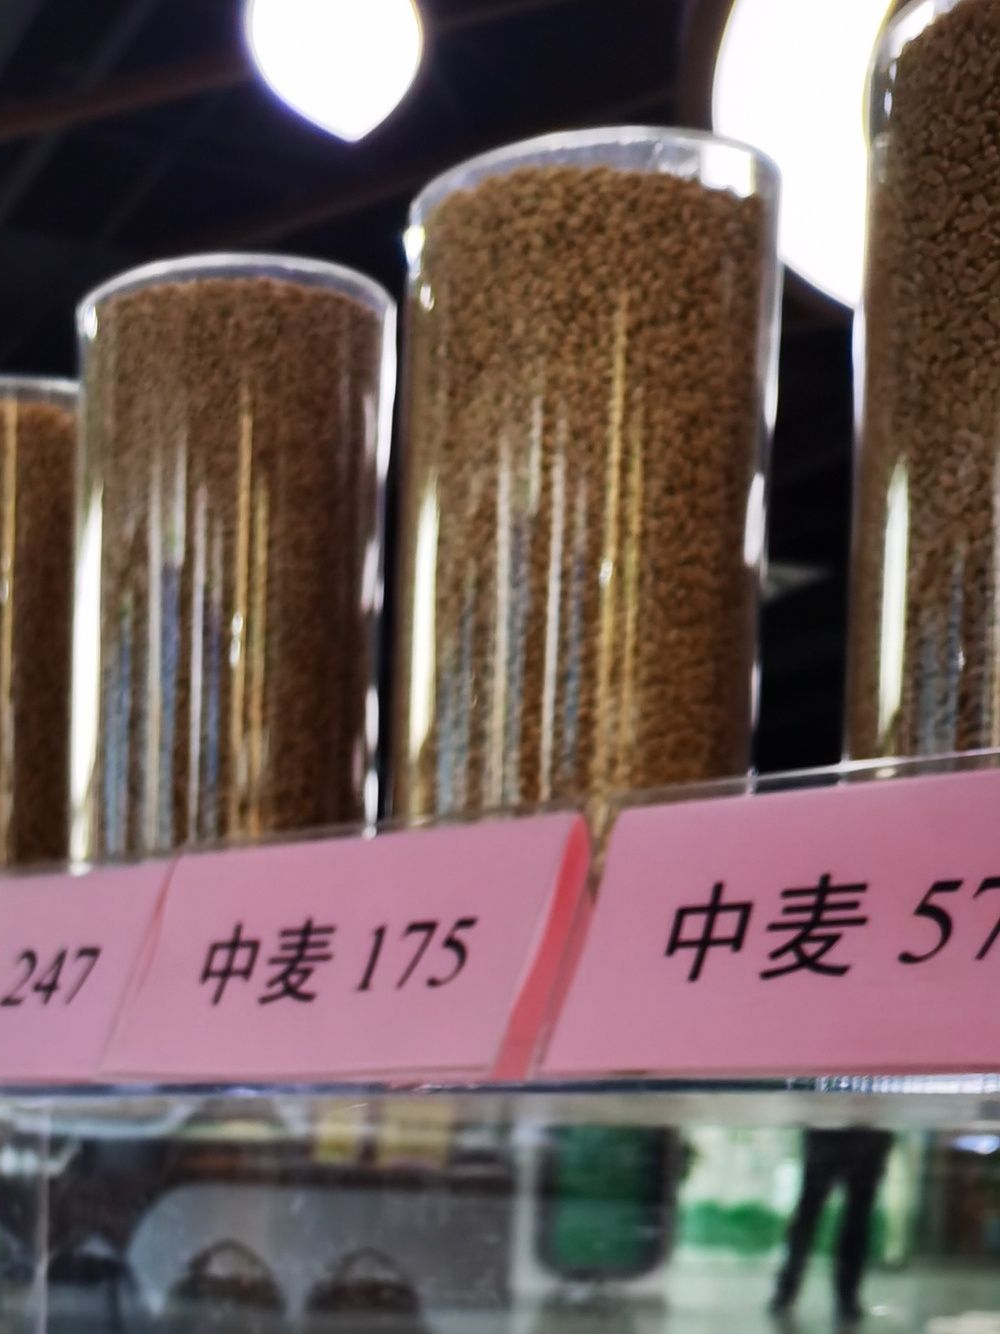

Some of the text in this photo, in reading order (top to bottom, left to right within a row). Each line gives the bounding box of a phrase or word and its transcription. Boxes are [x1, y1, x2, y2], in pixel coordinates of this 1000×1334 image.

[199, 916, 478, 1007] 中麦 175
[663, 872, 868, 983] 中麦
